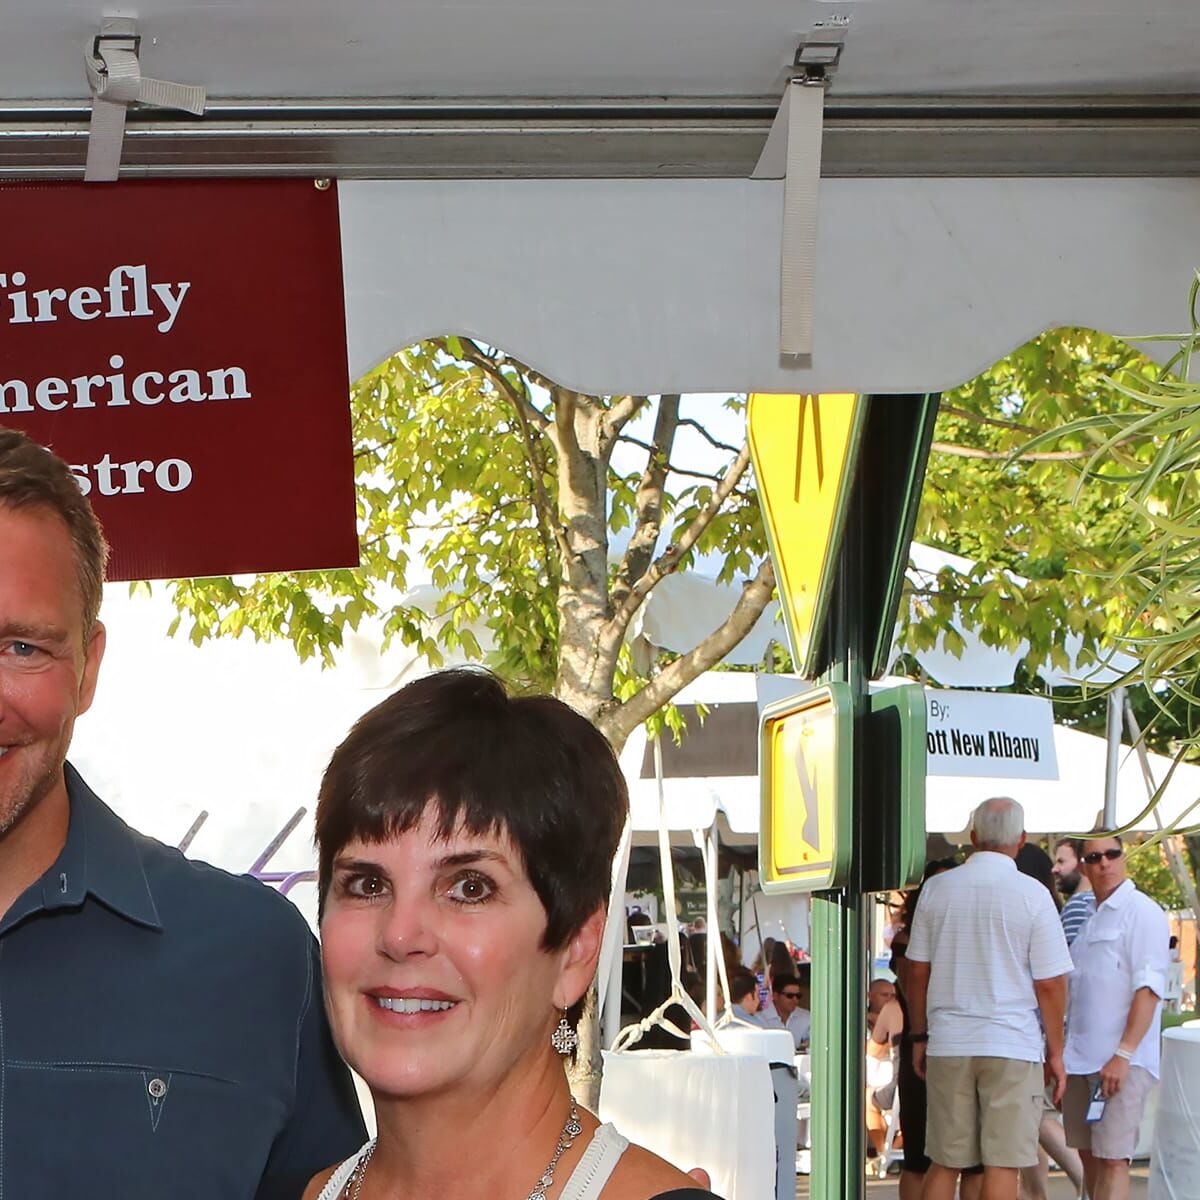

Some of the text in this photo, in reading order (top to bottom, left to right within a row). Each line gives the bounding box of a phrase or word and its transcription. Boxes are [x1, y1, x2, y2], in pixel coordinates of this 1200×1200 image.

[67, 454, 192, 496] stro
[931, 700, 949, 721] By:
[927, 729, 1039, 762] ott New Albany
